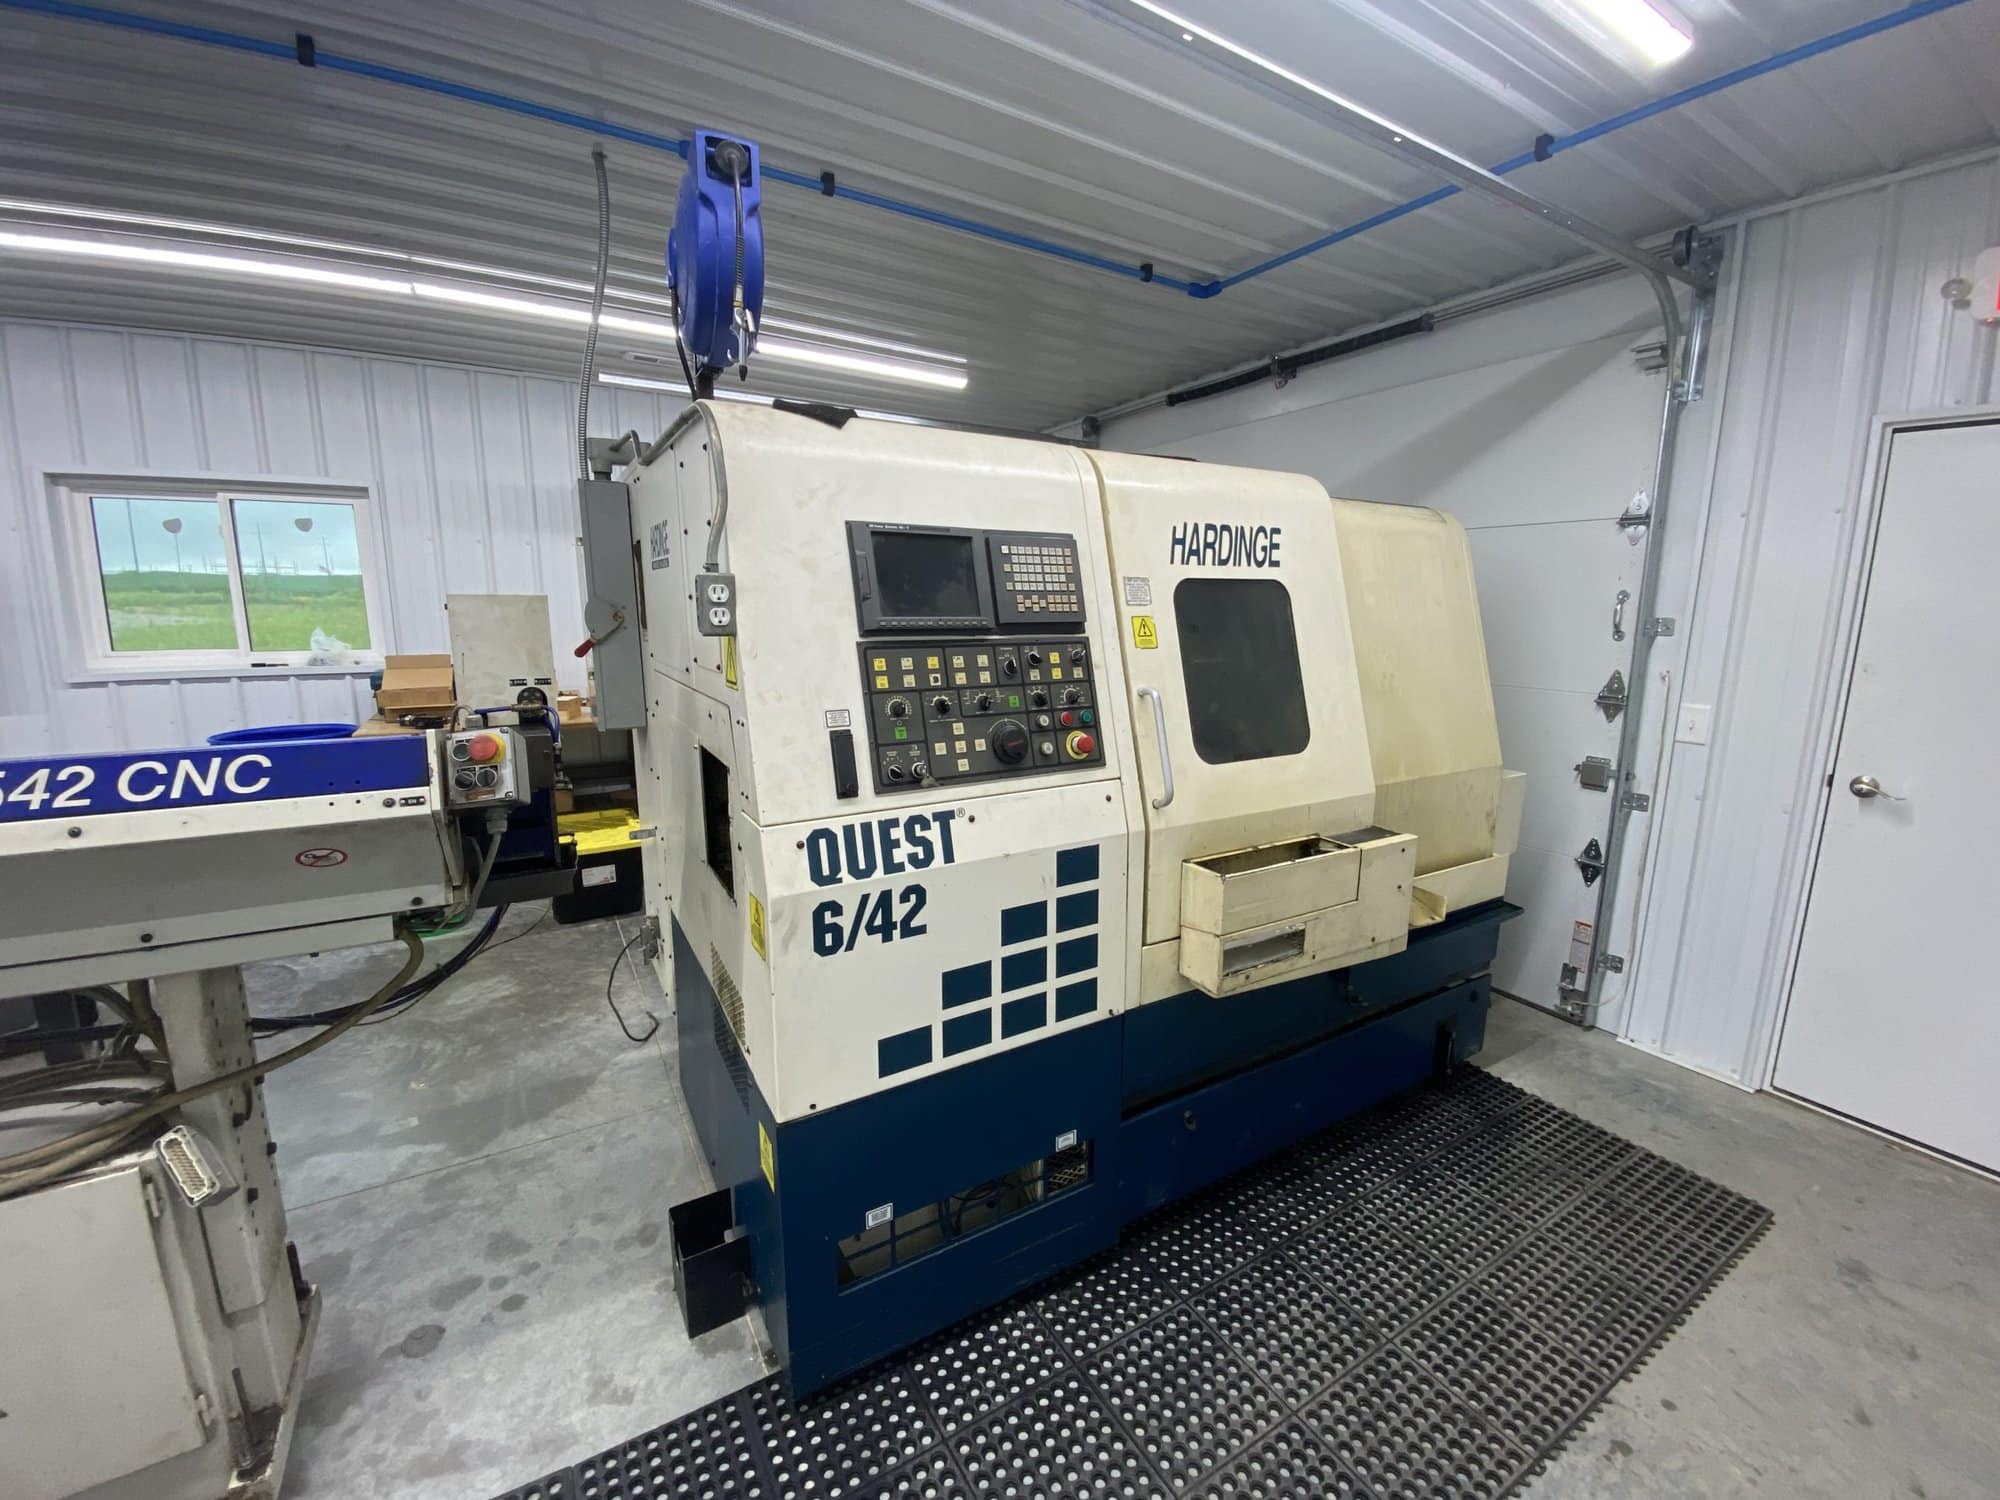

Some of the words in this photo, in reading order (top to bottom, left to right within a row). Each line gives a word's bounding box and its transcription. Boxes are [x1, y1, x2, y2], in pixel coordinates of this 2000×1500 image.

[1170, 521, 1281, 568] HARDINGE
[0, 764, 96, 811] 42
[117, 754, 273, 803] CNC
[812, 883, 928, 958] 6/42
